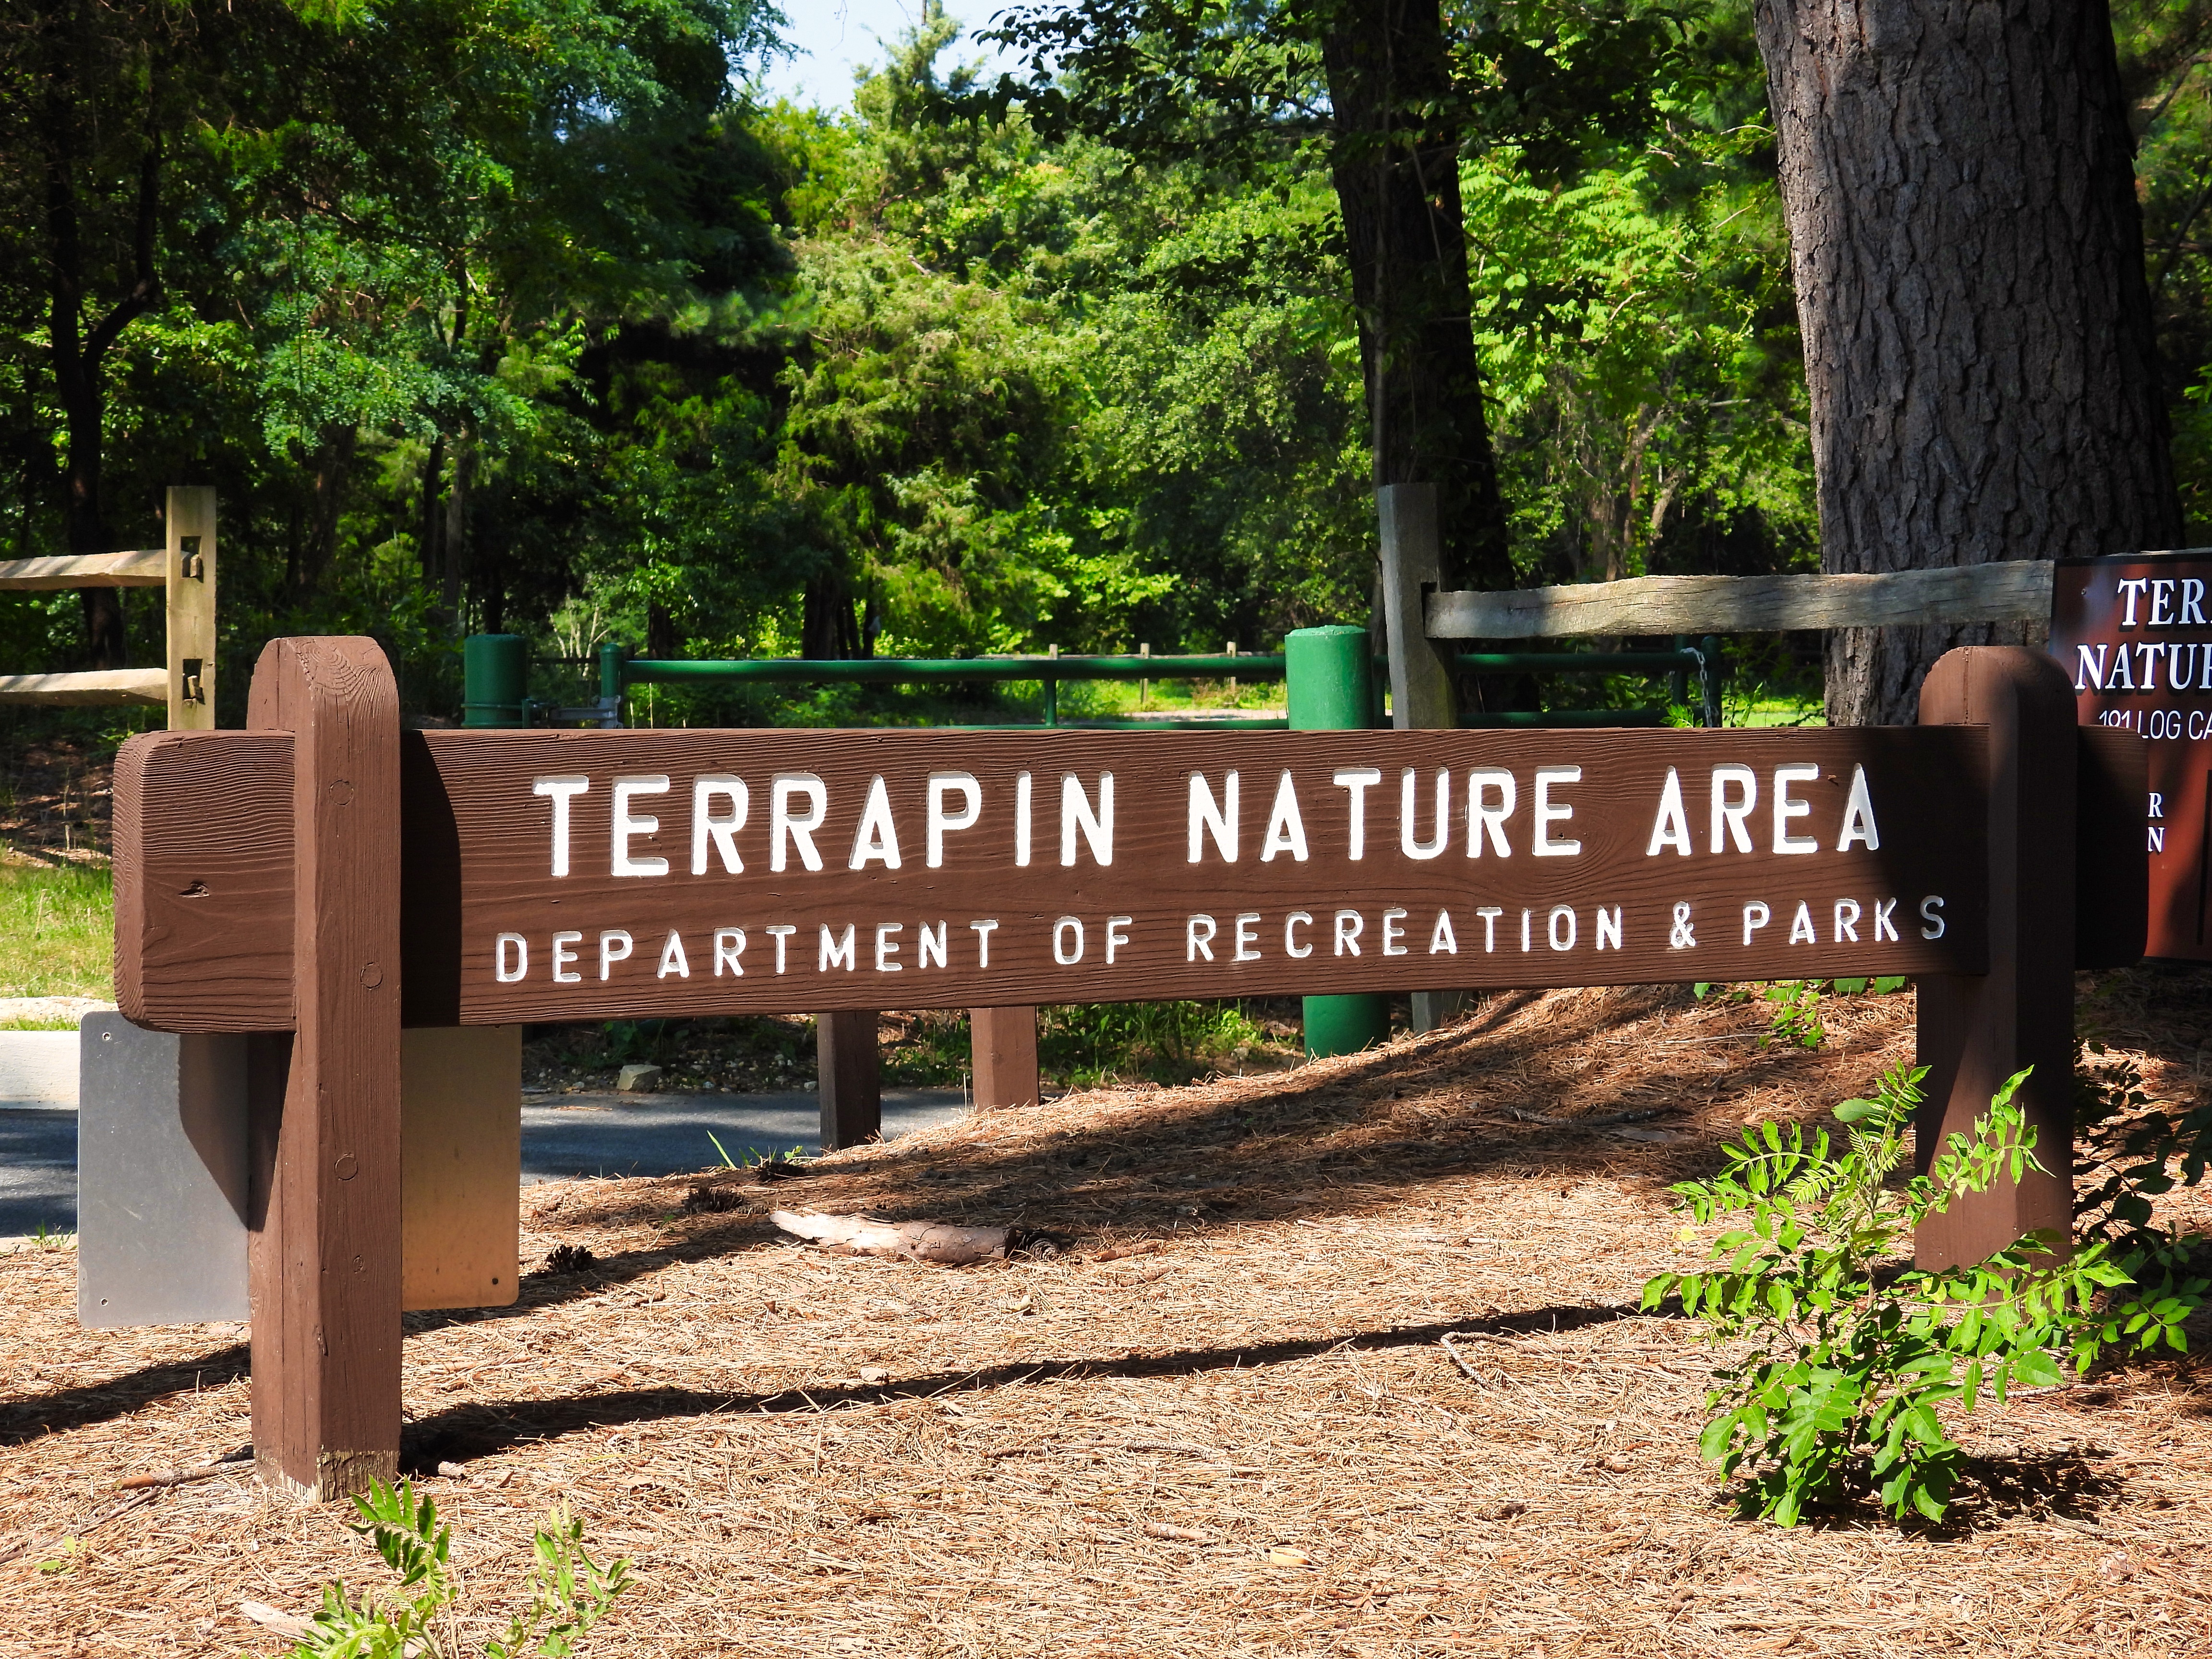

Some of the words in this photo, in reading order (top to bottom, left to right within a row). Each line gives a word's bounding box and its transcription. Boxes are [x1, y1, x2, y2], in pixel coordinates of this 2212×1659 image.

[2117, 577, 2212, 625] TER
[2138, 710, 2181, 740] LOG
[531, 770, 1115, 878] TERRAPIN
[1187, 765, 1583, 864] NATURE
[1646, 762, 1879, 856] AREA
[495, 919, 999, 983] DEPARTMENT
[1052, 916, 1132, 965] OF
[1187, 904, 1623, 962] RECREATION
[1668, 901, 1697, 950] &
[1743, 896, 1945, 947] PARKS
